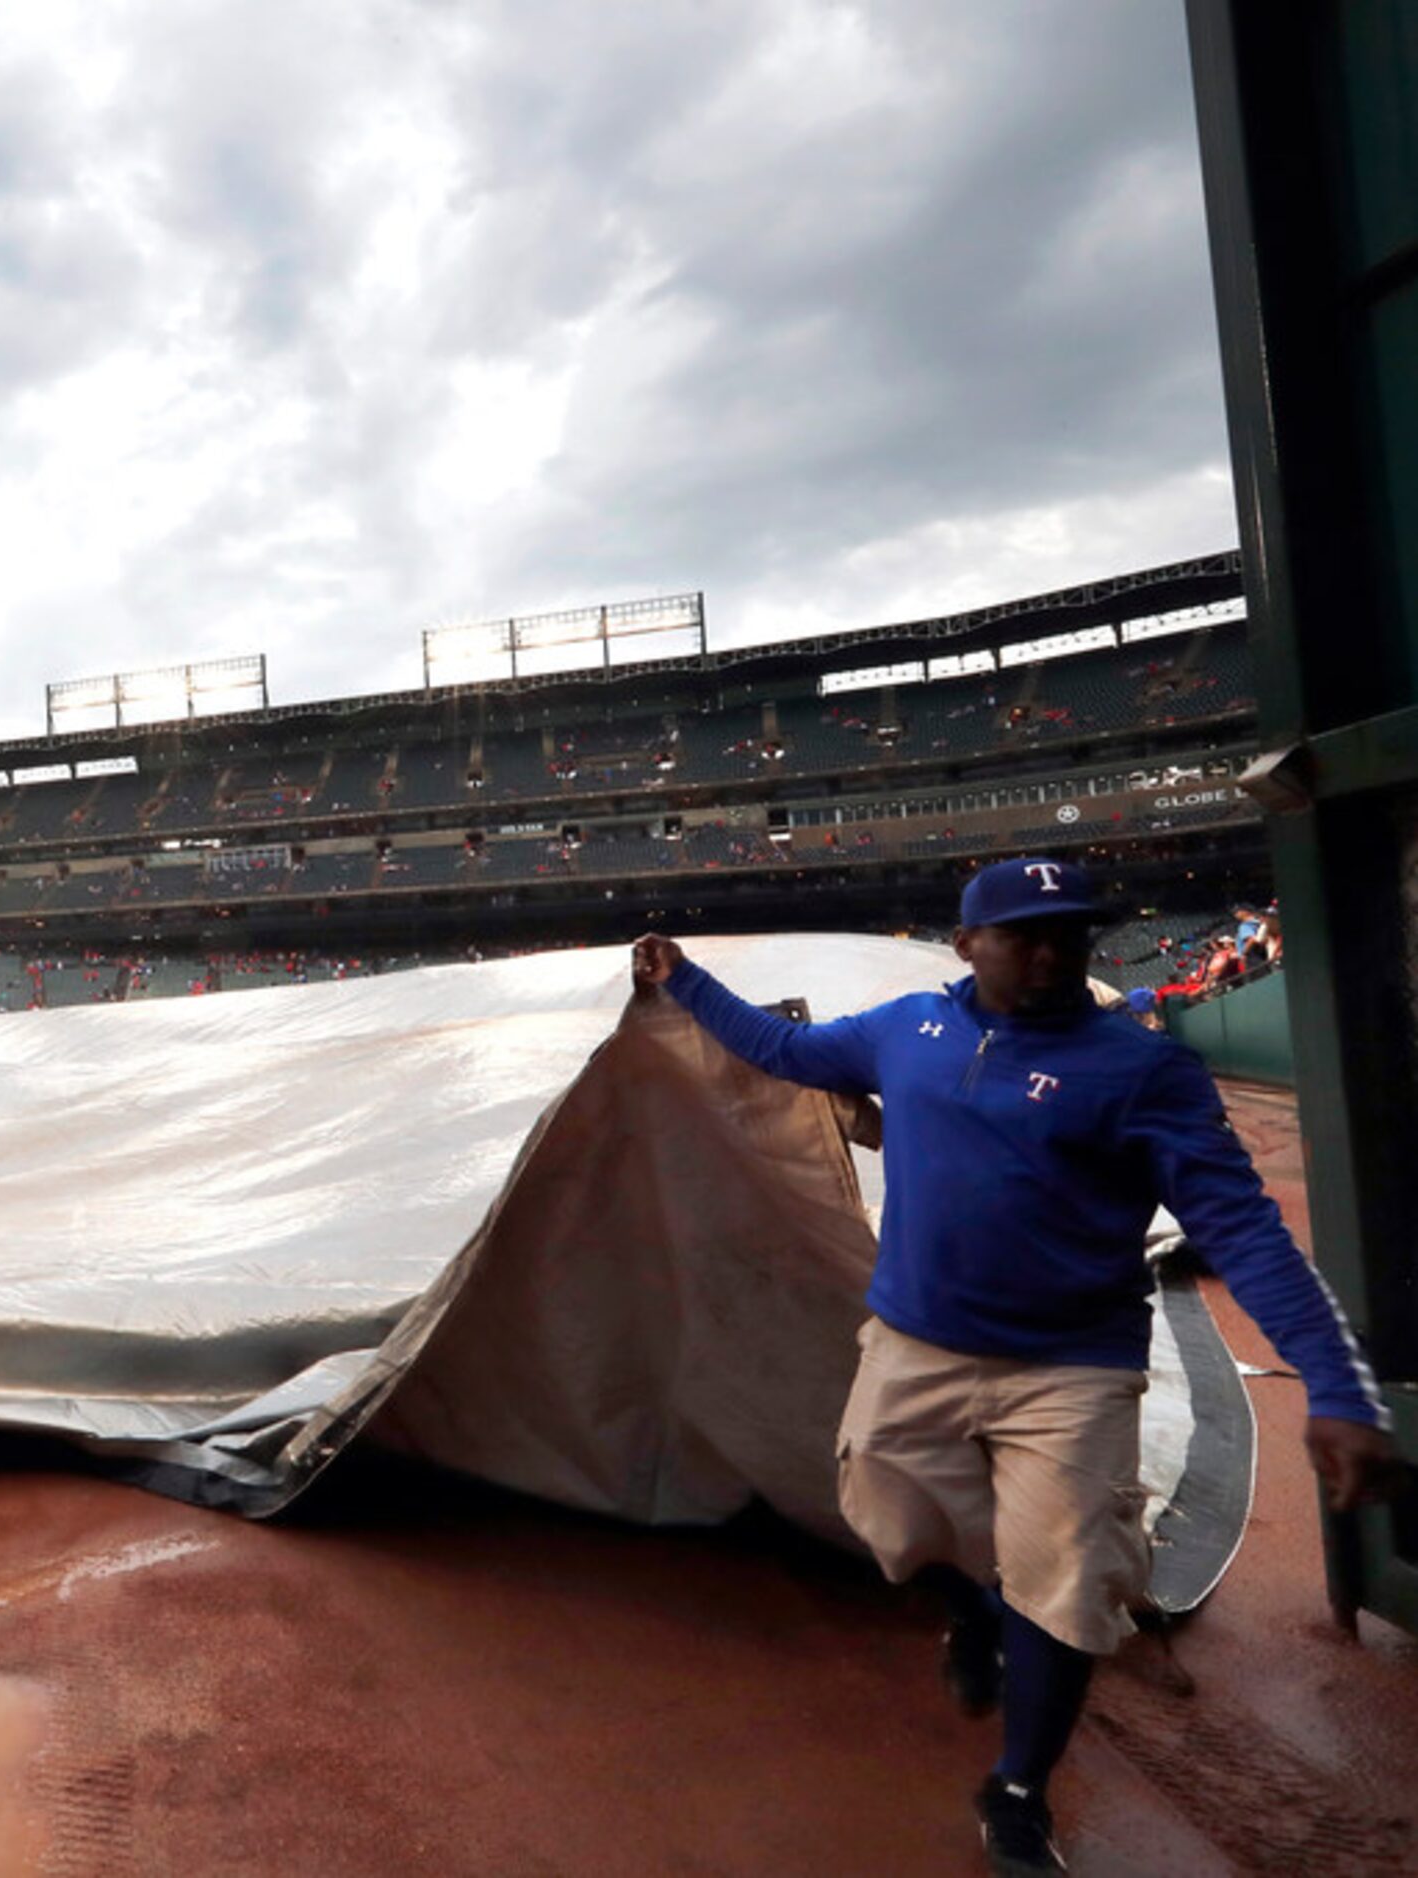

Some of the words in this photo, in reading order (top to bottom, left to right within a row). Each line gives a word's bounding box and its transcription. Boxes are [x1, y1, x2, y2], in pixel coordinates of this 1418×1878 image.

[1154, 787, 1227, 809] GLOBE
[1024, 863, 1062, 891] T
[1026, 1071, 1060, 1100] T
